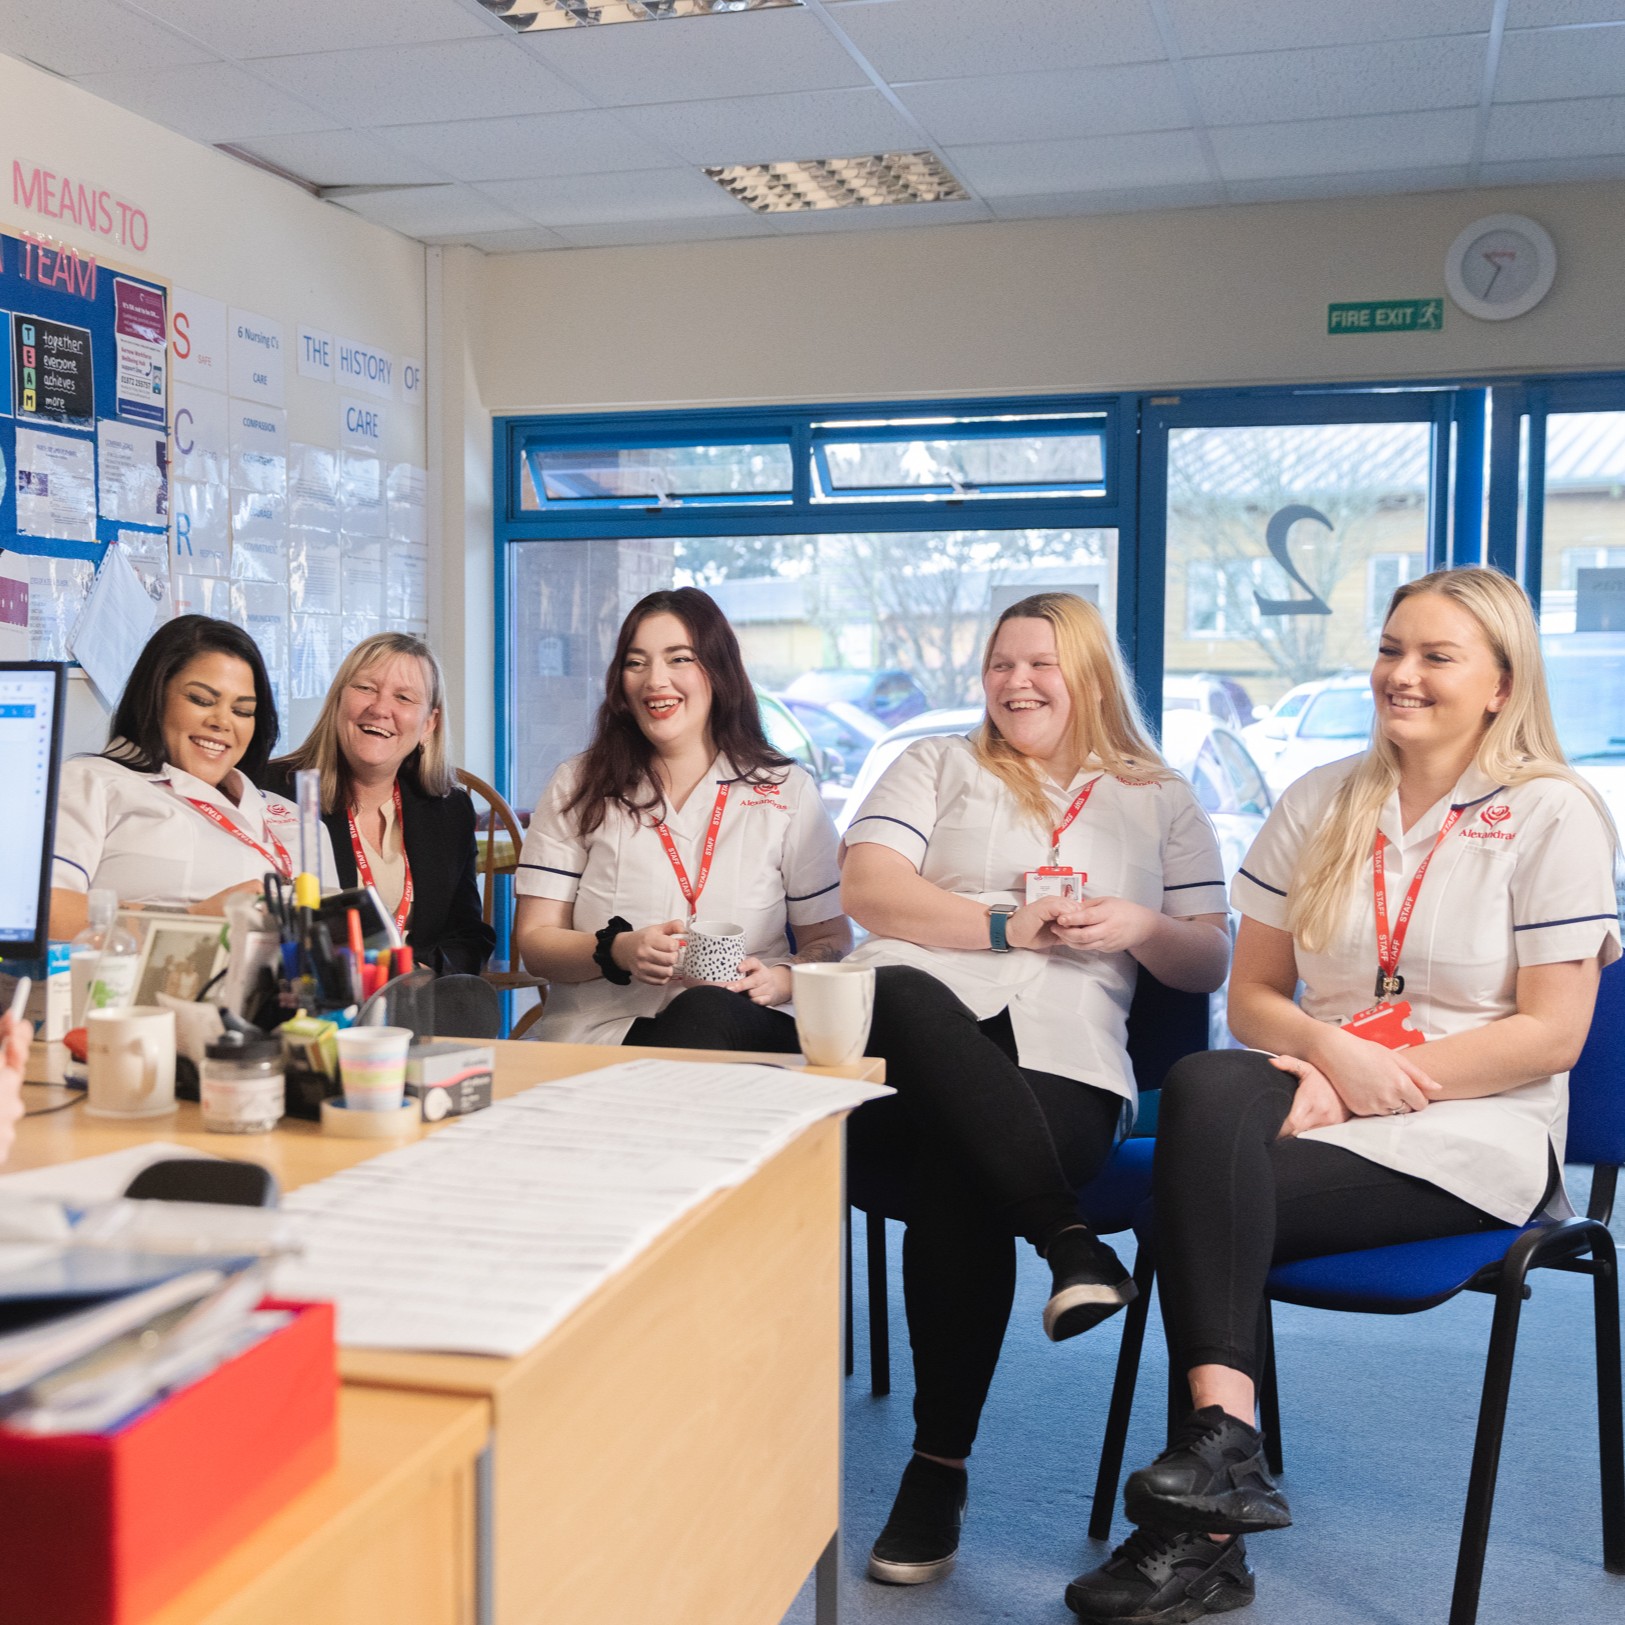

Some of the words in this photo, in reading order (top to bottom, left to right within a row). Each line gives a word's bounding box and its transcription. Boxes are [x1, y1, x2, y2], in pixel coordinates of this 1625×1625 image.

[13, 160, 113, 234] MEANS
[116, 201, 148, 252] TO
[19, 234, 96, 302] TEAM
[1331, 309, 1370, 328] FIRE
[1375, 307, 1413, 326] EXIT
[25, 327, 33, 342] T
[42, 331, 83, 353] together
[173, 312, 191, 360] S
[237, 326, 243, 338] 6
[244, 327, 272, 349] Nursing
[26, 350, 32, 364] E
[43, 355, 77, 371] everyone
[303, 335, 330, 368] THE
[340, 346, 392, 384] HISTORY
[404, 365, 420, 390] OF
[26, 371, 32, 386] A
[43, 372, 76, 390] achieves
[253, 372, 268, 386] CARE
[26, 393, 34, 407] M
[45, 397, 65, 408] more
[174, 408, 194, 455] C
[242, 417, 276, 433] COMPASSION
[346, 407, 379, 438] CARE
[176, 512, 193, 556] R
[200, 802, 223, 822] STAFF
[712, 806, 723, 826] STAFF
[1442, 810, 1459, 835] STAFF
[231, 827, 255, 847] STAFF
[348, 820, 358, 839] STAFF
[1459, 829, 1517, 841] Alexandras
[668, 847, 680, 866] STAFF
[705, 837, 715, 856] STAFF
[356, 850, 367, 869] STAFF
[1375, 849, 1384, 875] STAFF
[679, 876, 692, 898] STAFF
[698, 867, 709, 889] STAFF
[1376, 890, 1385, 917] STAFF
[1400, 896, 1413, 923] STAFF
[1379, 934, 1389, 962] STAFF
[1389, 938, 1400, 966] STAFF
